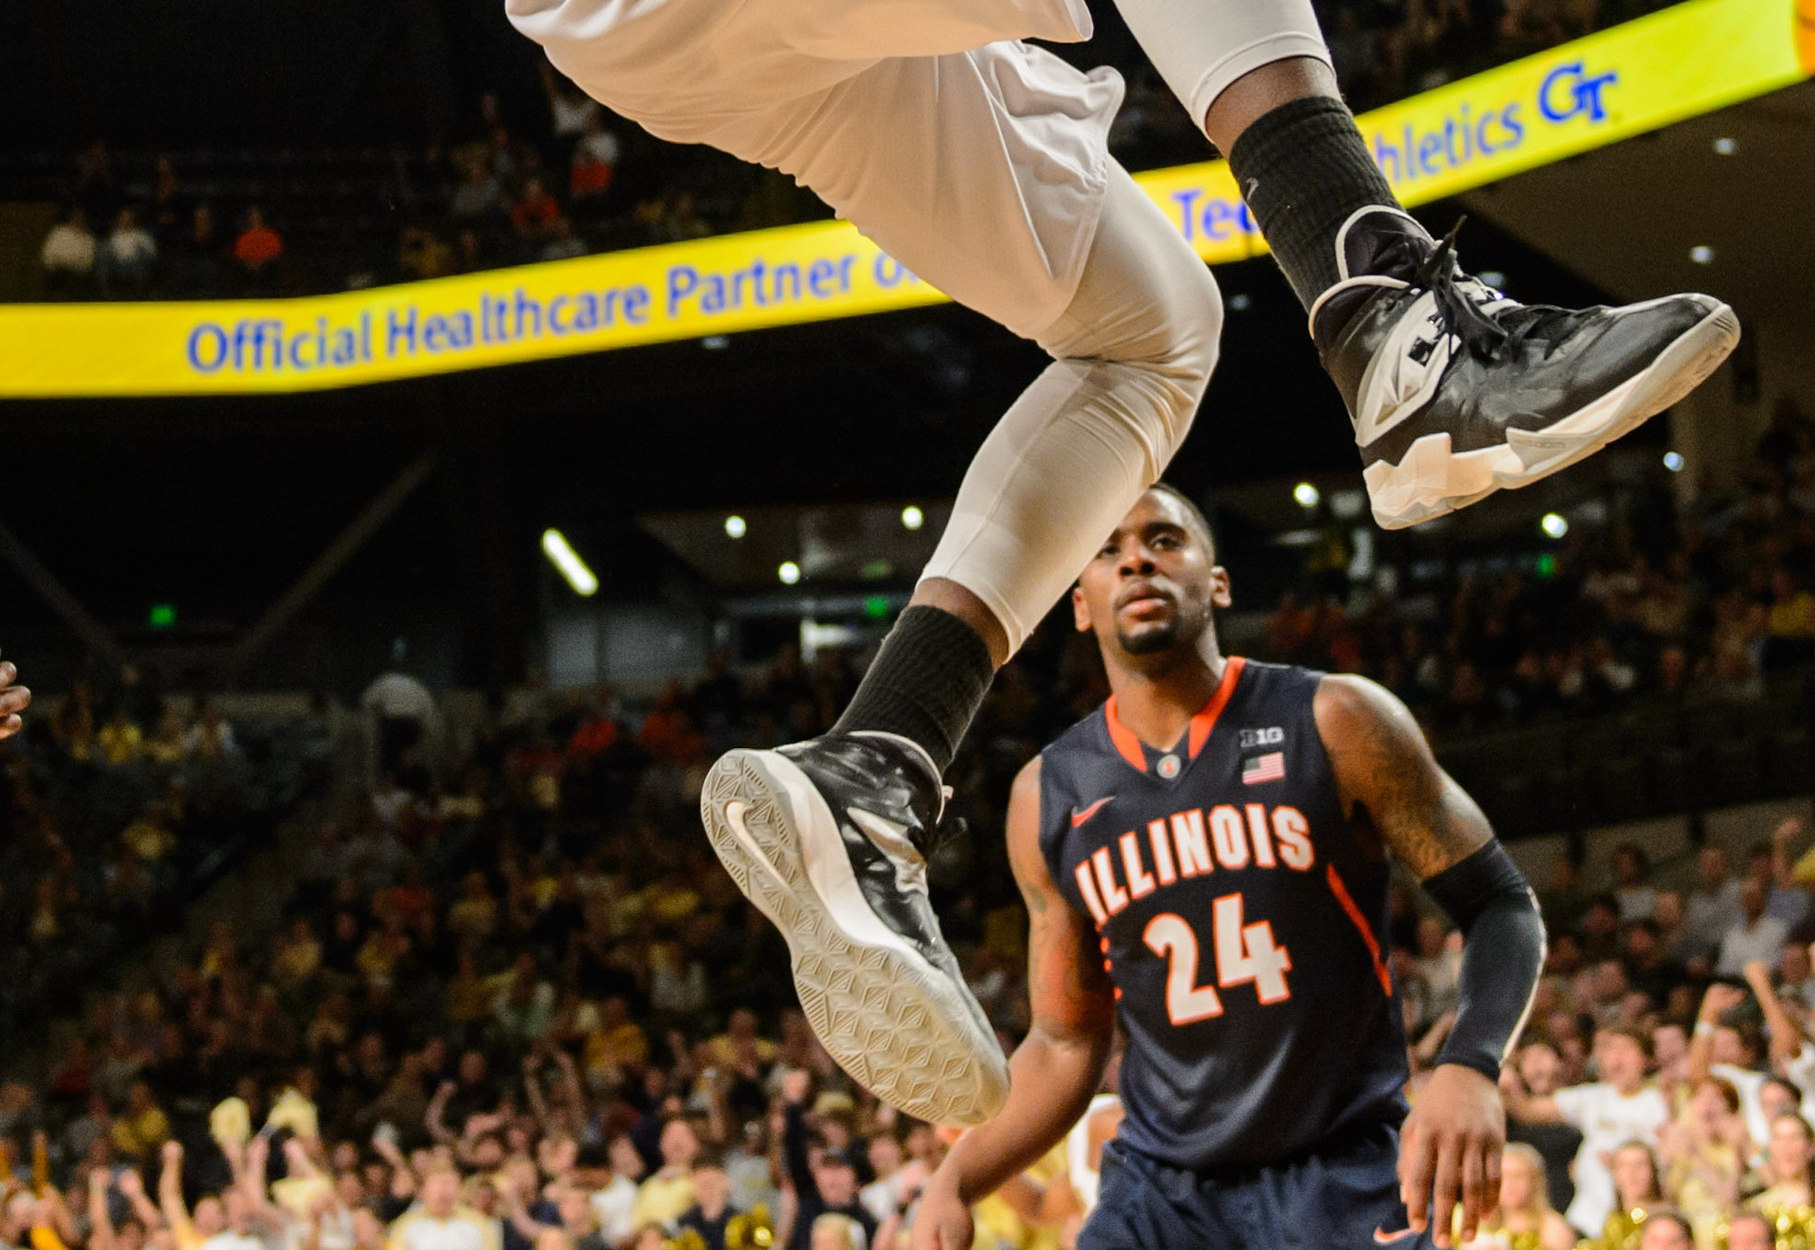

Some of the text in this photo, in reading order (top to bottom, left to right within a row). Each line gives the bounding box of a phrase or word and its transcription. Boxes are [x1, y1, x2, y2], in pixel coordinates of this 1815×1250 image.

[187, 310, 374, 373] Official
[385, 284, 652, 357] Healthcare
[666, 252, 856, 317] Partner
[873, 251, 919, 288] o
[1074, 802, 1316, 930] ILLINOIS
[1142, 892, 1293, 1027] 24
